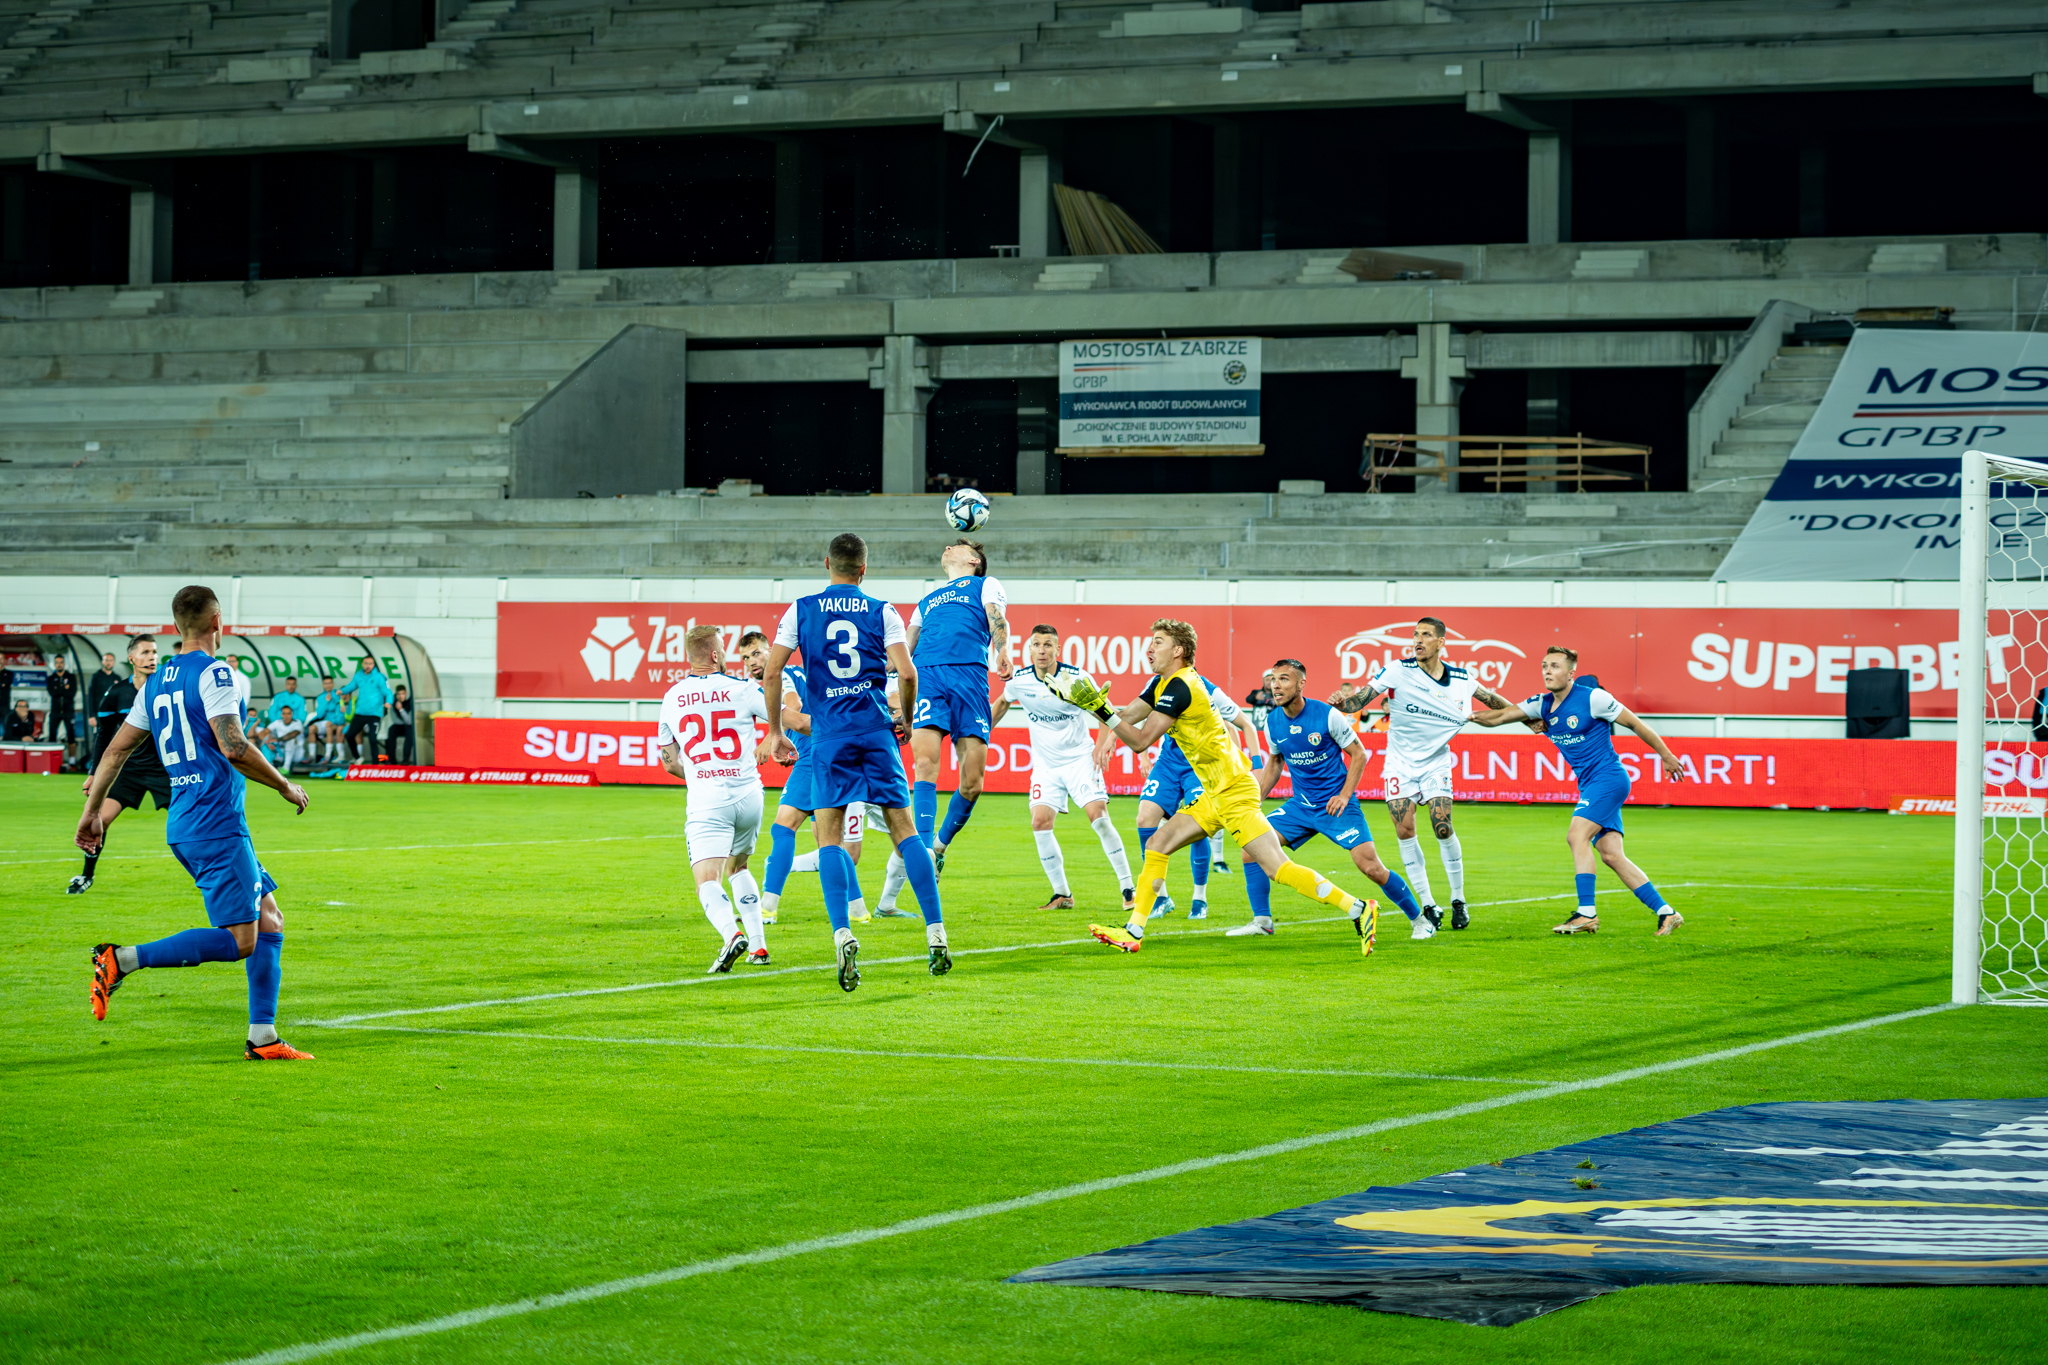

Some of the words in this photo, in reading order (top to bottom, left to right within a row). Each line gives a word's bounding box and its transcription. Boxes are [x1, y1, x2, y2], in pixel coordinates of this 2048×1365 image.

[1073, 342, 1176, 358] MOSTOSTAL
[1181, 340, 1248, 356] ZABRZE
[1073, 376, 1108, 389] GPBP
[1073, 400, 1137, 411] WYKONAWCA
[1171, 399, 1247, 410] BUDOWLANYCH
[1149, 421, 1194, 431] BUDOWY
[1195, 420, 1247, 431] STADIONU
[1161, 433, 1172, 443] W
[1838, 425, 2007, 448] GPBP
[818, 597, 869, 612] YAKUBA
[647, 616, 762, 662] Zaz
[826, 619, 861, 679] 3
[678, 690, 732, 708] SIPLAK
[153, 690, 197, 767] 21
[679, 709, 742, 765] 25
[1290, 751, 1315, 759] MIASTO
[359, 768, 406, 779] STRAUSS
[418, 771, 465, 782] STRAUSS
[480, 771, 527, 782] STRAUSS
[541, 773, 590, 784] STRAUSS
[1142, 779, 1159, 796] 23
[1385, 776, 1400, 797] 13
[1536, 791, 1580, 801] uzależ
[1899, 798, 1956, 812] STIHL
